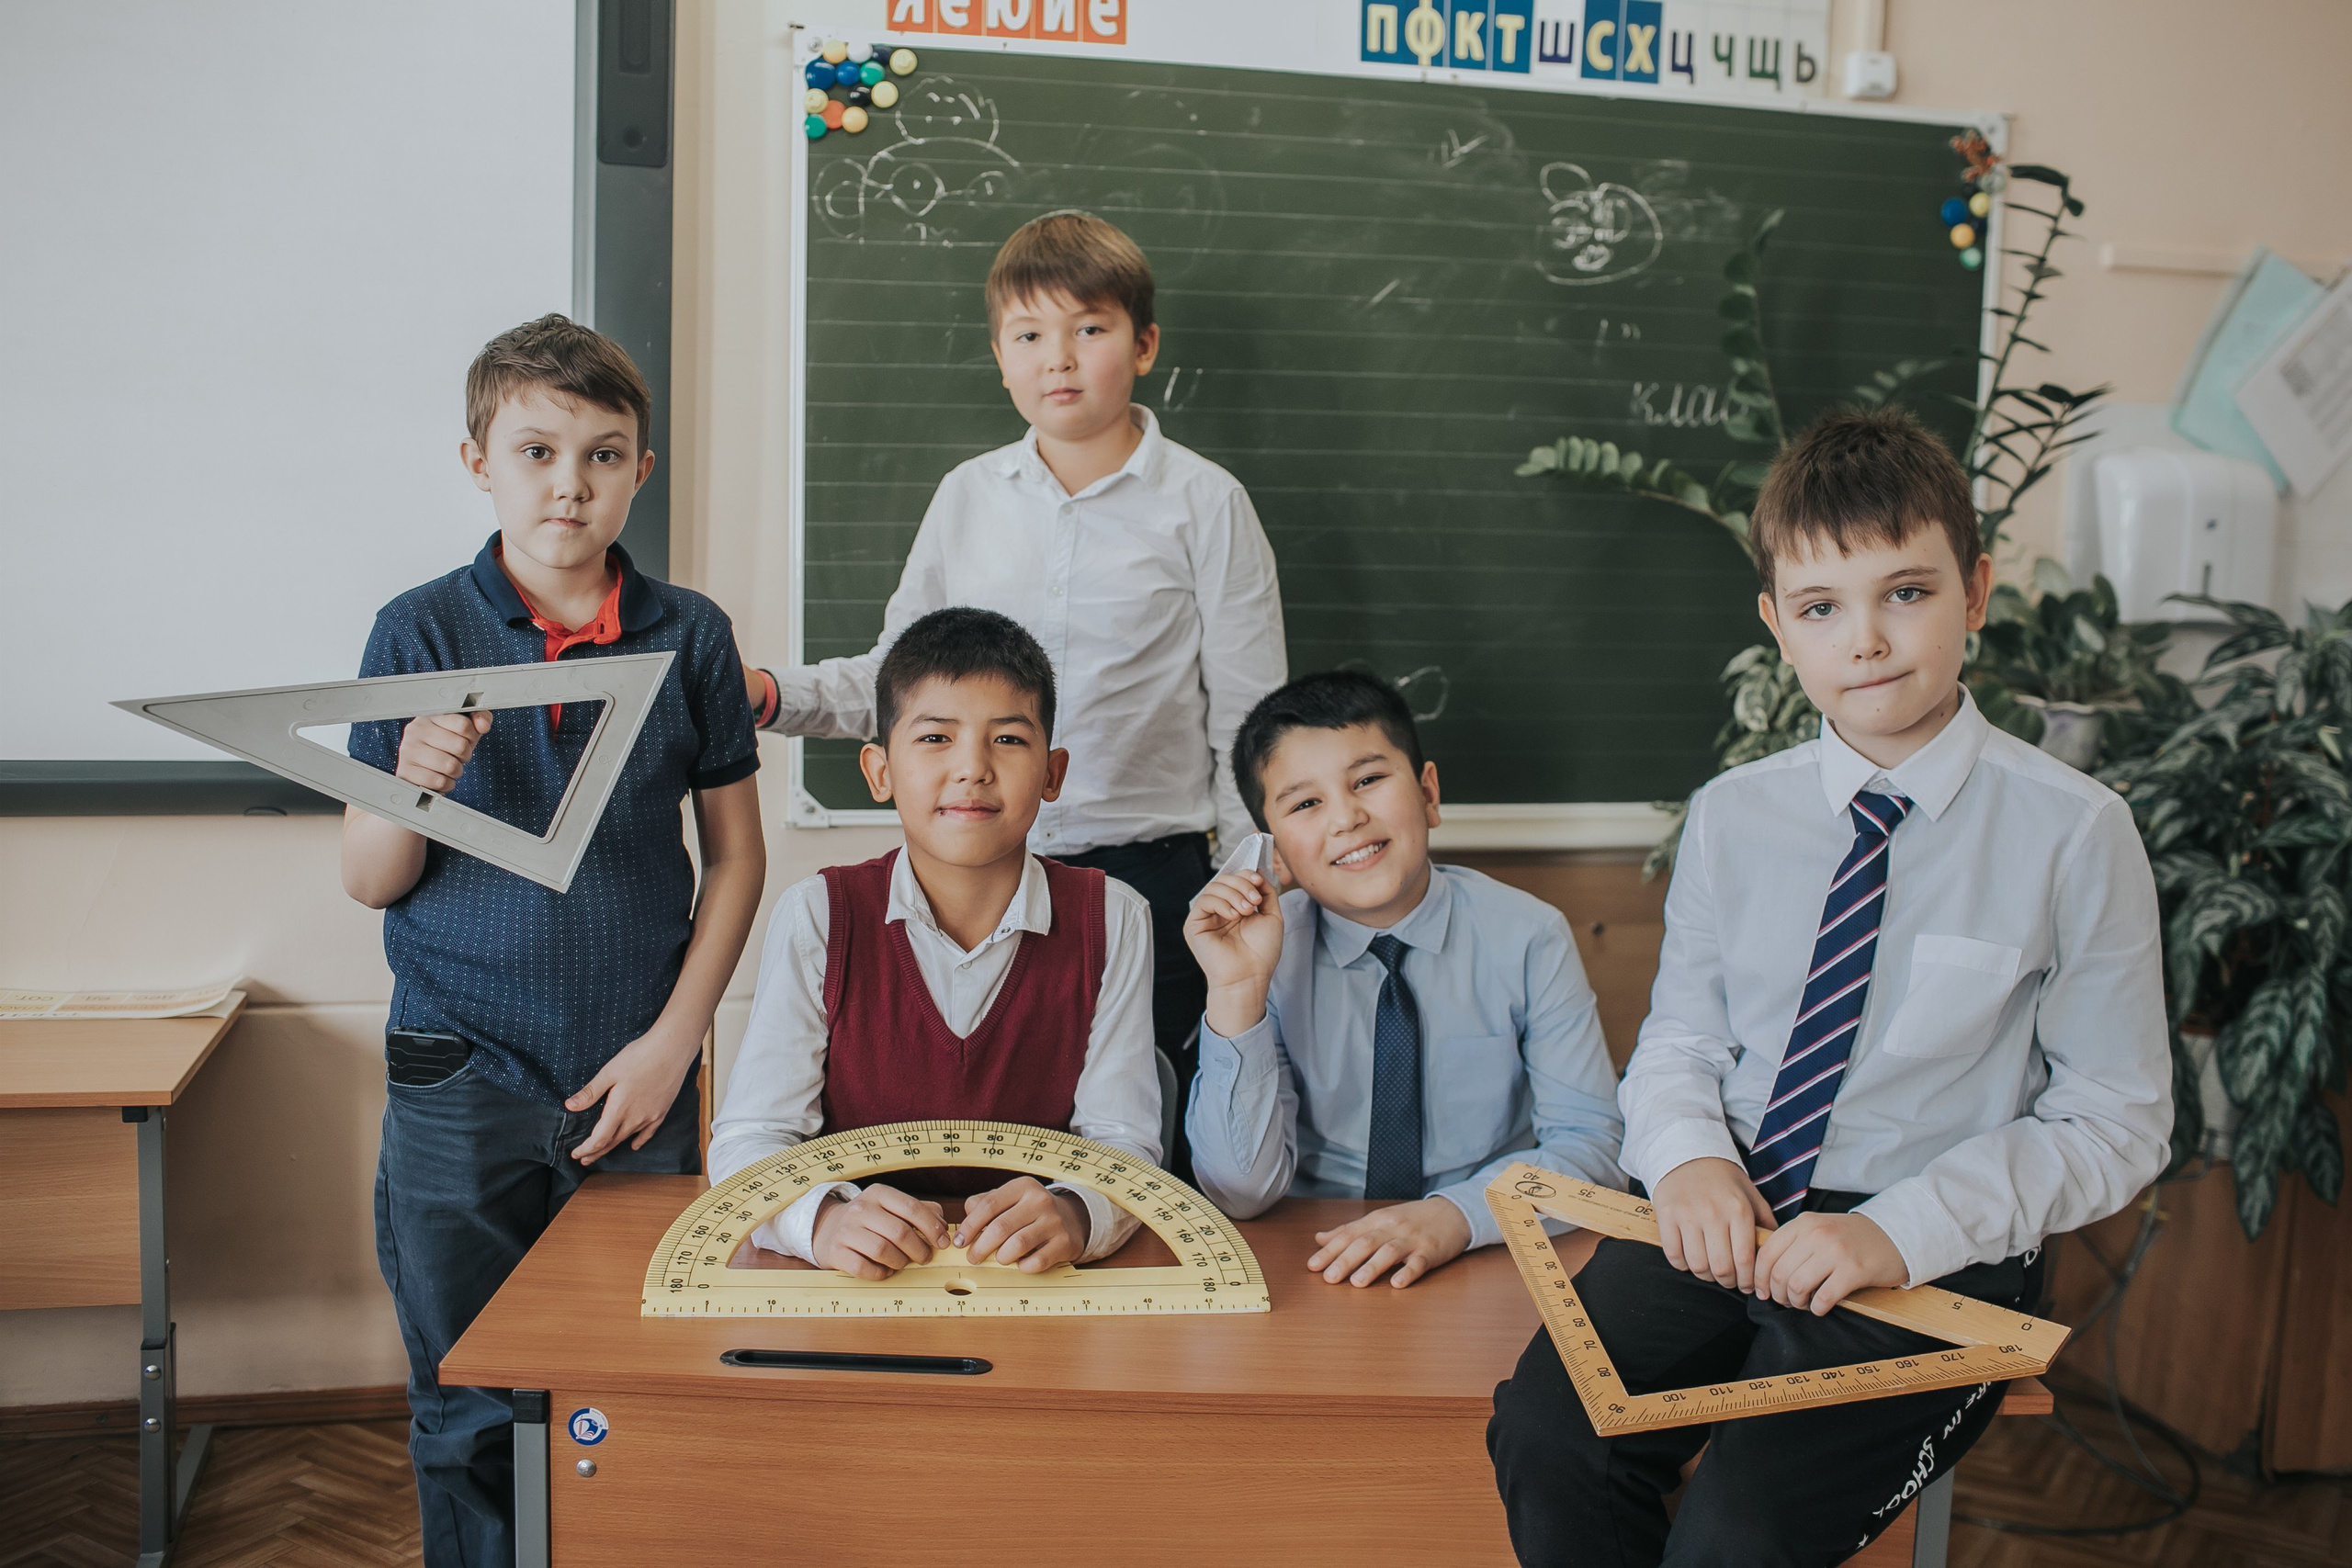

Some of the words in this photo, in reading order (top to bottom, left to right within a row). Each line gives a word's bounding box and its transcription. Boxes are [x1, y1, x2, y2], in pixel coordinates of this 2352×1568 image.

[896, 1134, 920, 1143] 100
[943, 1133, 960, 1141] 90
[854, 1139, 876, 1150] 110
[1030, 1139, 1047, 1148] 70
[812, 1149, 836, 1161] 120
[1071, 1149, 1089, 1159] 60
[776, 1163, 797, 1176] 130
[1109, 1163, 1127, 1173] 50
[1523, 1172, 1540, 1181] 40
[742, 1180, 763, 1194] 140
[1145, 1180, 1161, 1191] 40
[1578, 1188, 1596, 1198] 35
[714, 1201, 734, 1215] 150
[1175, 1201, 1192, 1213] 30
[1635, 1204, 1653, 1215] 30
[704, 1255, 718, 1267] 10
[717, 1232, 732, 1244] 20
[737, 1210, 753, 1223] 30
[763, 1190, 779, 1202] 40
[792, 1175, 810, 1187] 50
[827, 1162, 844, 1173] 60
[864, 1153, 882, 1162] 70
[903, 1147, 921, 1156] 80
[944, 1145, 961, 1154] 90
[981, 1147, 1005, 1156] 100
[1021, 1152, 1044, 1161] 110
[1059, 1160, 1081, 1171] 120
[1094, 1172, 1116, 1185] 130
[1126, 1188, 1148, 1201] 140
[1154, 1207, 1173, 1222] 150
[1175, 1228, 1194, 1244] 160
[1192, 1251, 1208, 1268] 170
[1203, 1276, 1216, 1292] 180
[692, 1224, 709, 1239] 160
[1200, 1224, 1216, 1236] 20
[677, 1251, 693, 1266] 170
[1217, 1251, 1231, 1262] 10
[671, 1278, 684, 1293] 180
[1952, 1302, 1963, 1310] 5
[1523, 1219, 1536, 1228] 10
[1534, 1241, 1547, 1250] 20
[1544, 1261, 1557, 1271] 30
[1554, 1280, 1566, 1290] 40
[1563, 1297, 1577, 1308] 50
[1573, 1317, 1586, 1328] 60
[1584, 1339, 1598, 1350] 70
[1597, 1367, 1611, 1377] 80
[1609, 1403, 1625, 1414] 90
[1662, 1393, 1687, 1403] 100
[1709, 1385, 1734, 1396] 110
[1748, 1380, 1773, 1391] 120
[1786, 1374, 1810, 1385] 130
[1821, 1370, 1846, 1381] 140
[1856, 1365, 1881, 1375] 150
[1894, 1359, 1919, 1370] 160
[1940, 1351, 1965, 1362] 170
[1998, 1343, 2023, 1354] 180
[2020, 1322, 2032, 1331] 0
